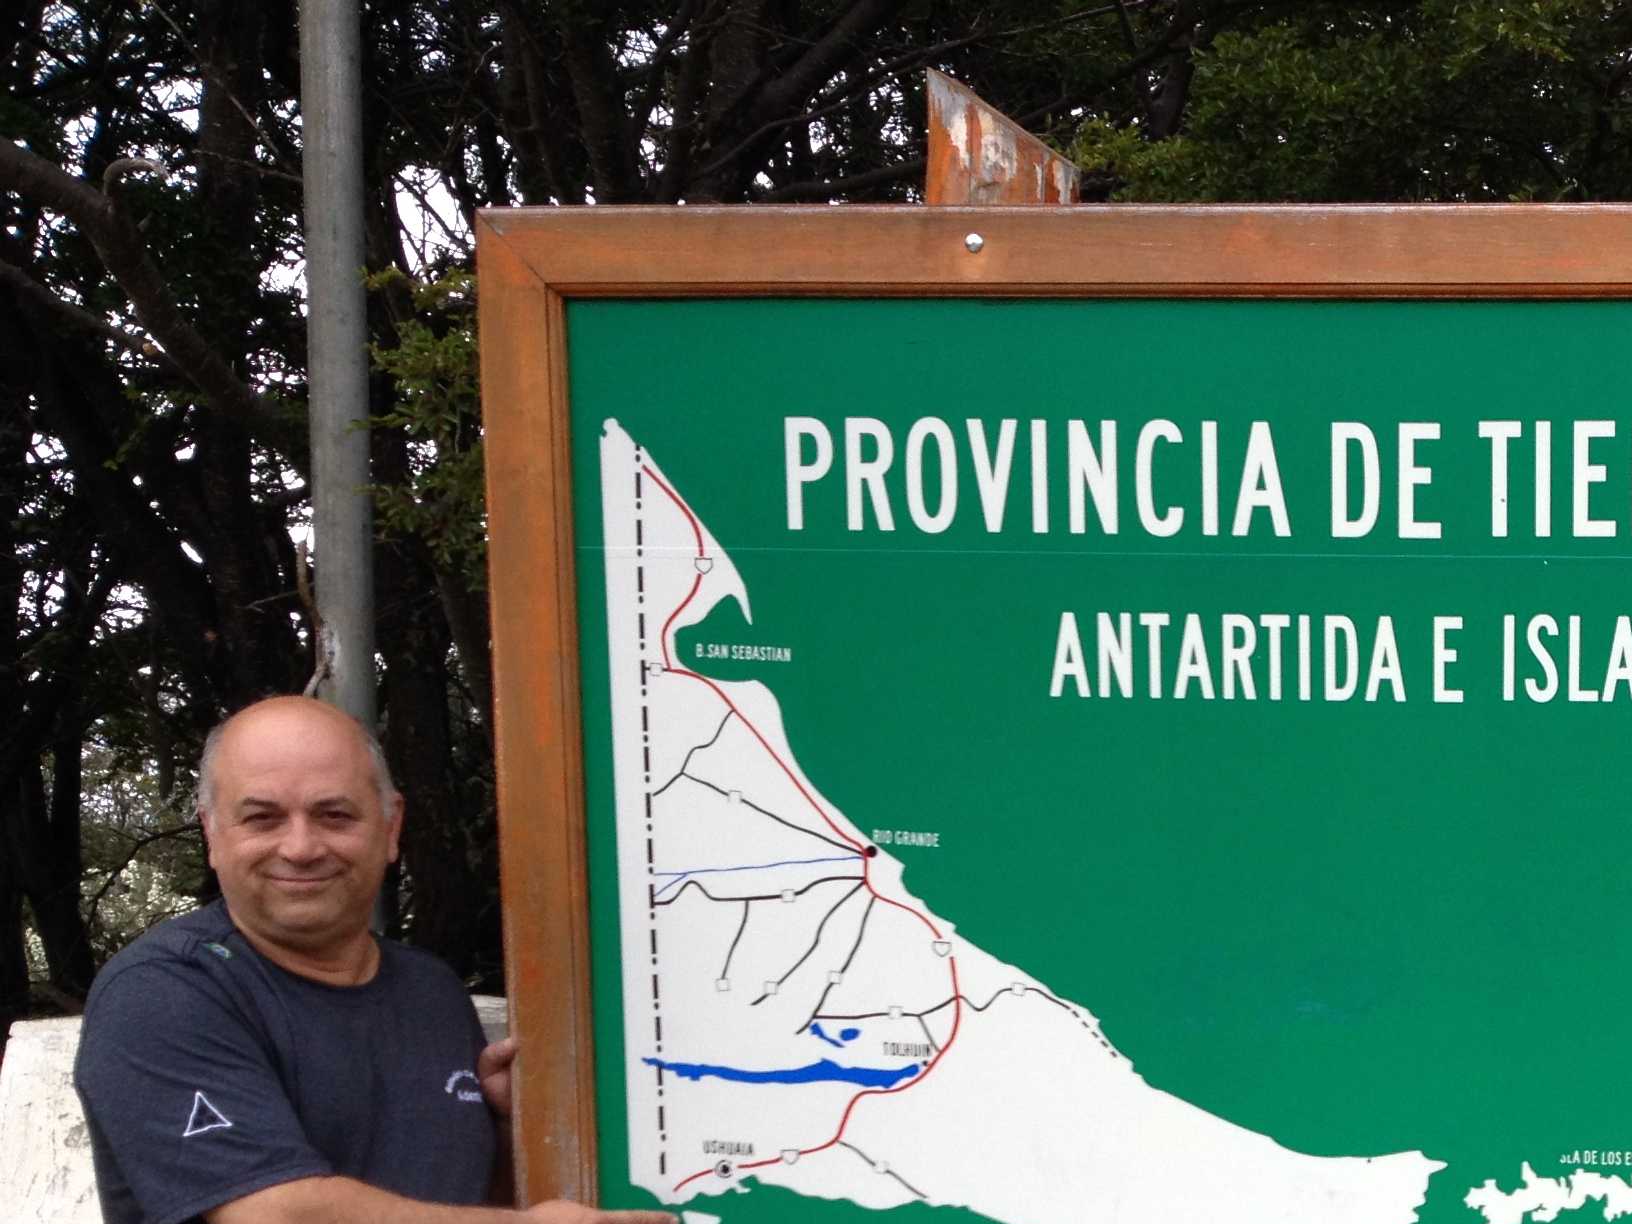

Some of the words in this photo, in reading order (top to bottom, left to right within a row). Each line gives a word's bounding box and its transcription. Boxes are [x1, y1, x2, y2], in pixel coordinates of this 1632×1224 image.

[784, 416, 1292, 538] PROVINCIA
[1331, 421, 1442, 539] DE
[731, 645, 791, 662] SEBASTIAN
[1049, 611, 1407, 702] ANTARTIDA
[1433, 615, 1464, 703] E
[894, 830, 940, 848] GRANDE
[702, 1139, 754, 1155] USHUAIA
[1584, 1150, 1599, 1165] DE
[1602, 1151, 1622, 1166] LOS
